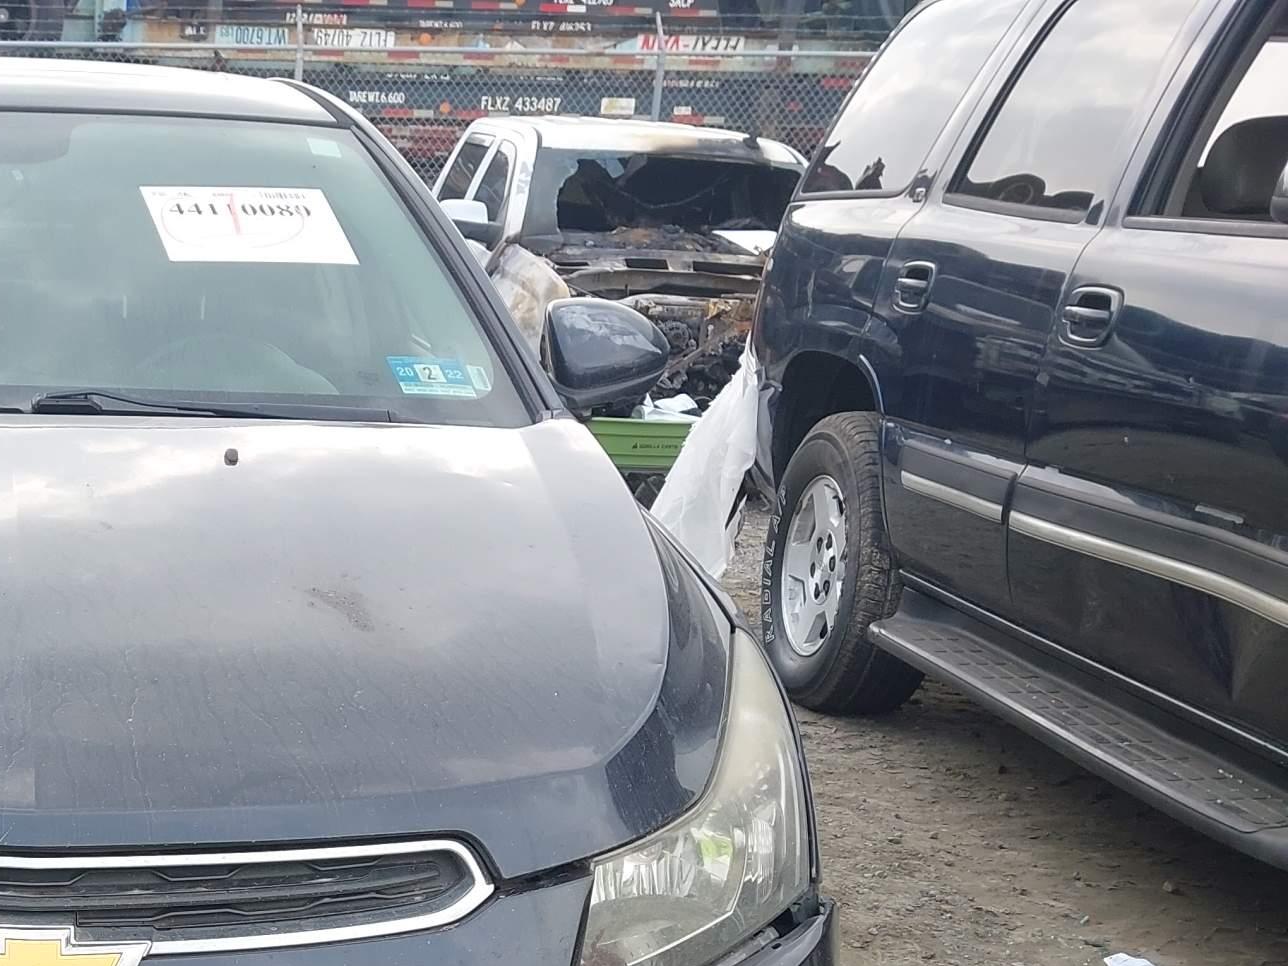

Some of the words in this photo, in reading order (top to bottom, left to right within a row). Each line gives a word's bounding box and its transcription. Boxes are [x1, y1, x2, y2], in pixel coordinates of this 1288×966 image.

[481, 95, 510, 111] FLXZ
[514, 96, 561, 112] 433487
[396, 366, 414, 377] 20
[422, 366, 437, 380] 2
[445, 369, 464, 379] 22
[763, 539, 776, 643] RADIAL
